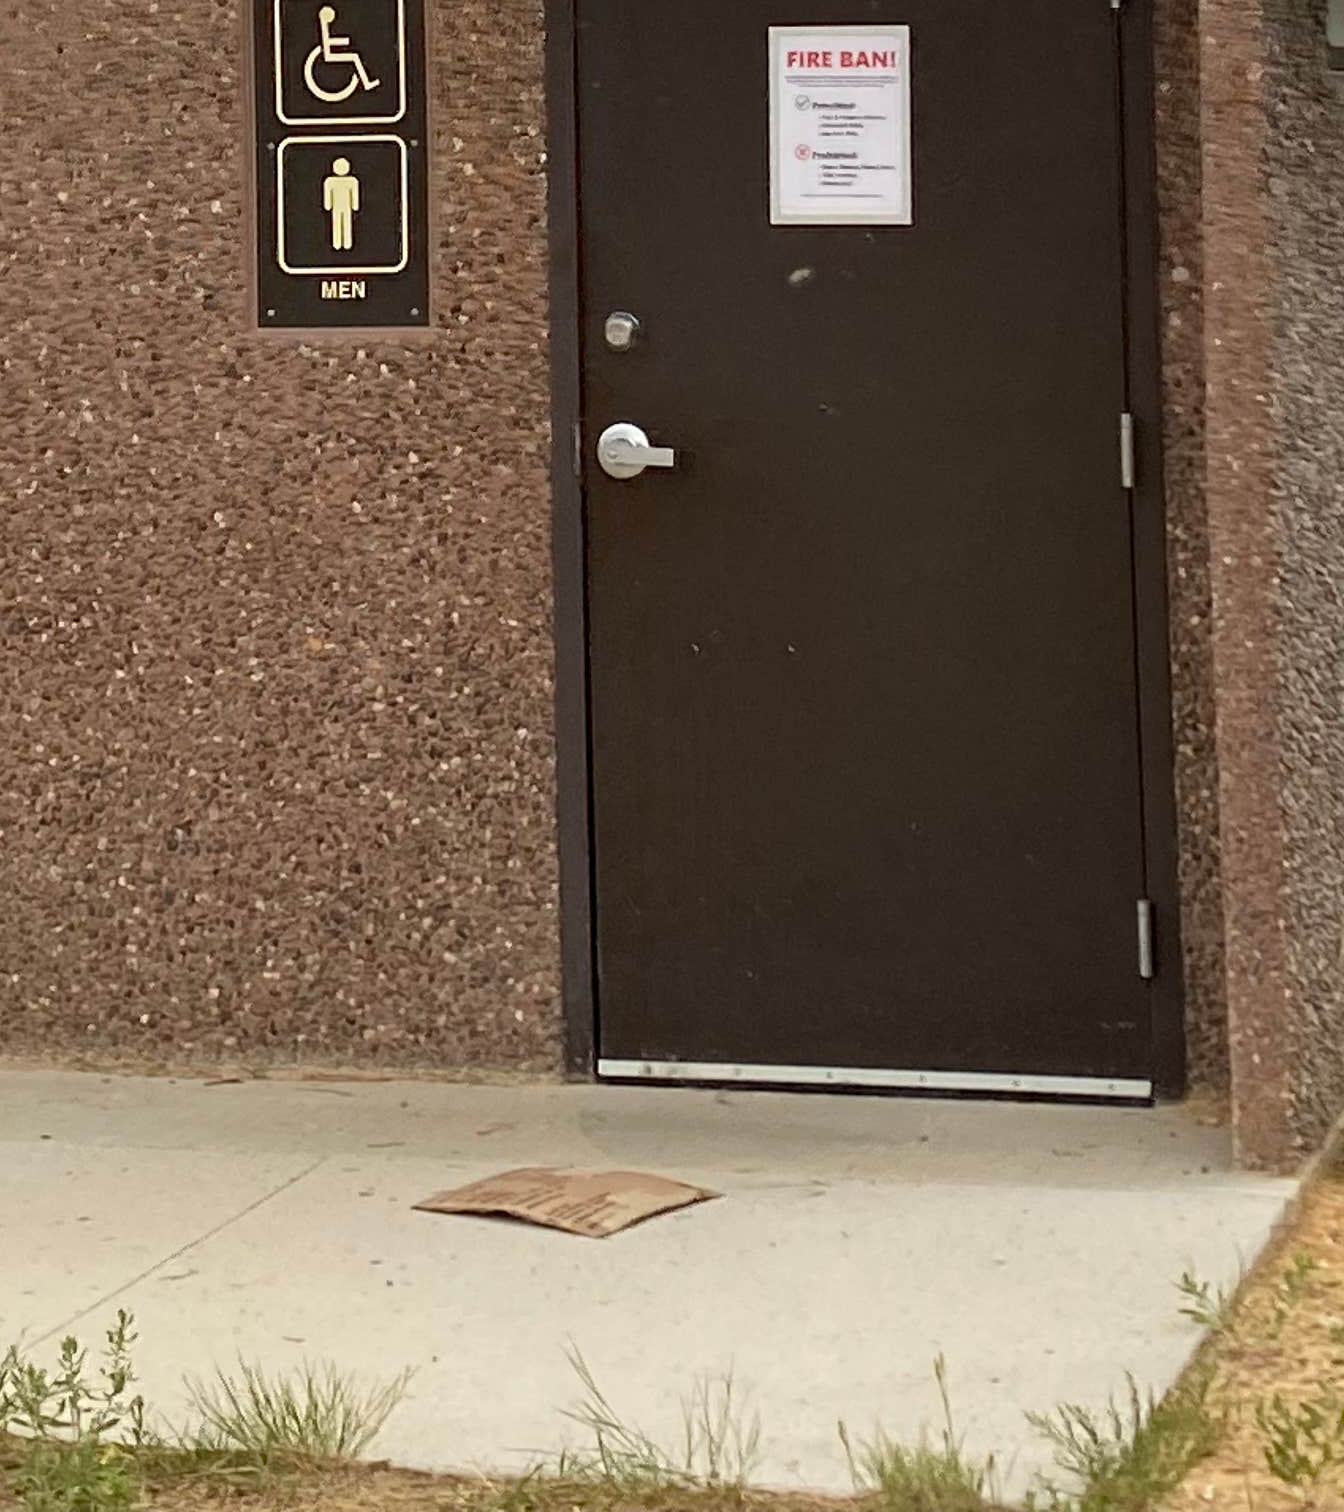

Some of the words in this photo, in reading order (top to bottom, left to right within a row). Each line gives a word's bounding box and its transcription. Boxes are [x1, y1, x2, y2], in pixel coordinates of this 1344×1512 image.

[787, 51, 833, 68] FIRE
[840, 51, 896, 68] BAN!
[321, 281, 366, 299] MEN
